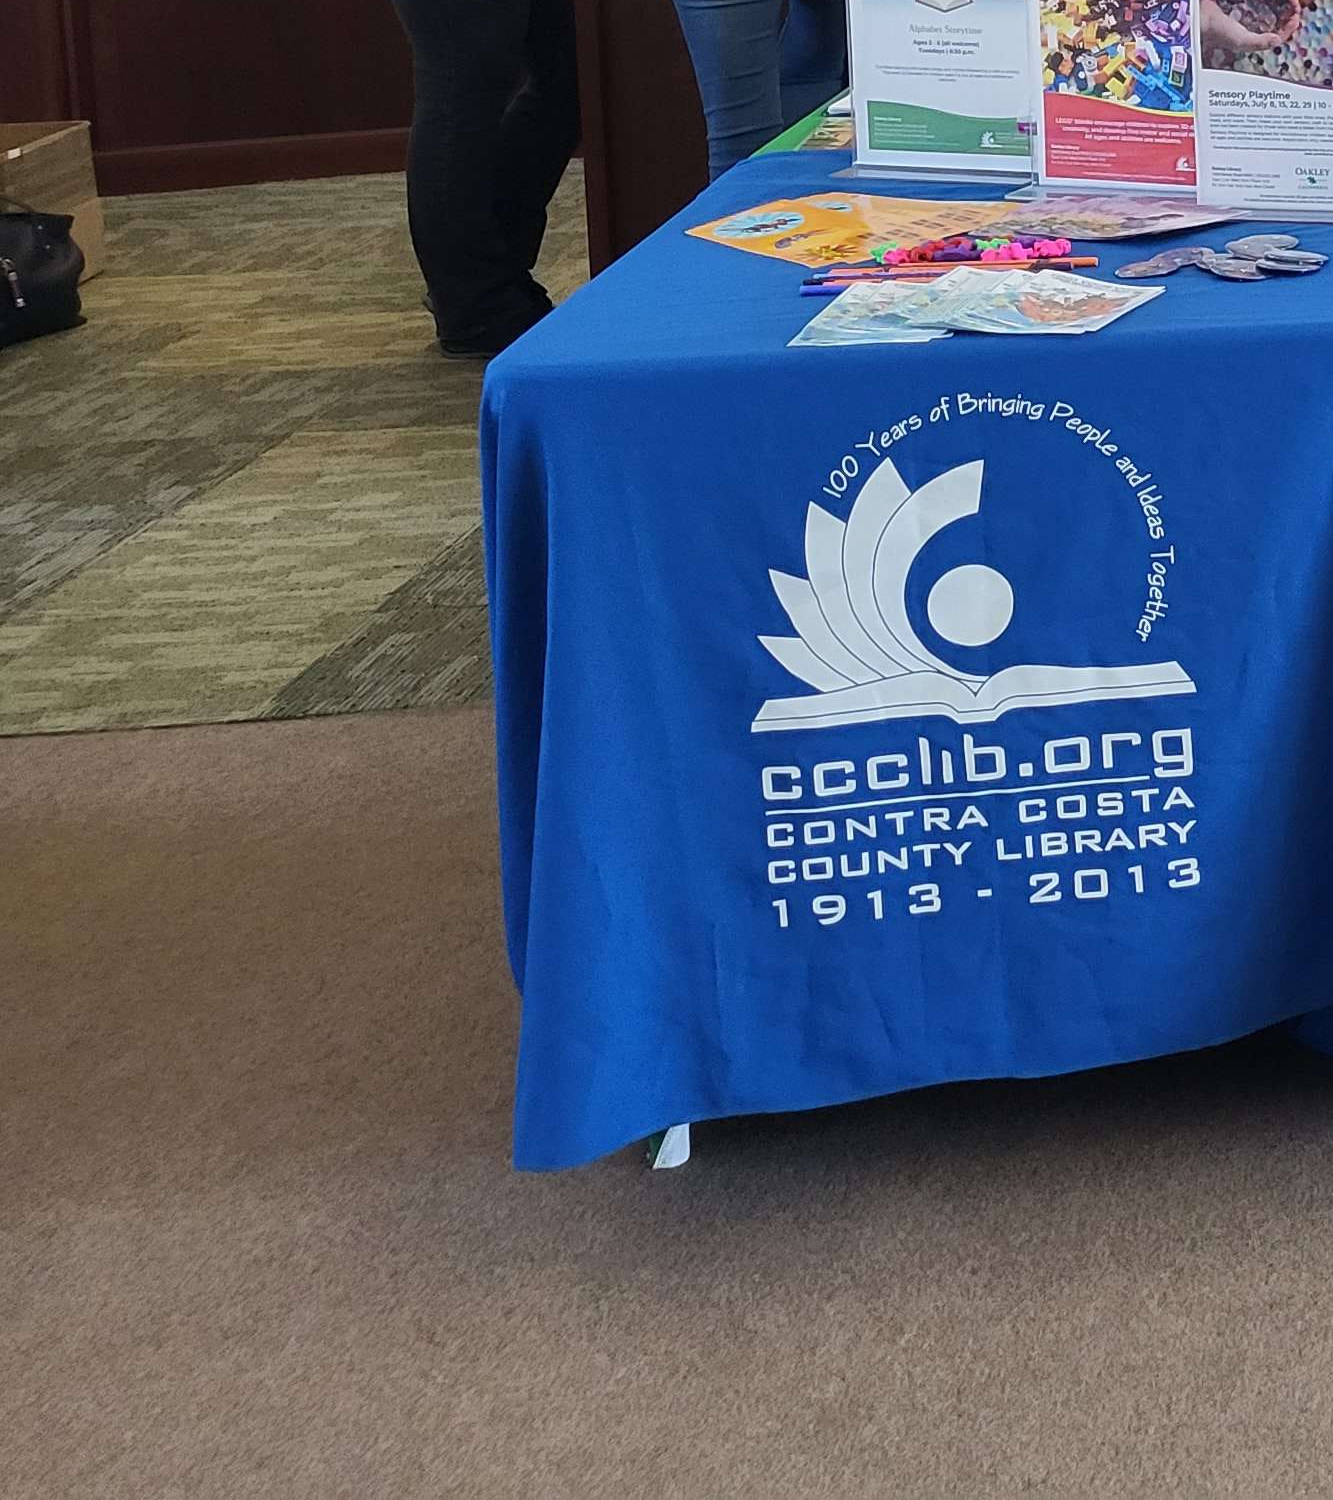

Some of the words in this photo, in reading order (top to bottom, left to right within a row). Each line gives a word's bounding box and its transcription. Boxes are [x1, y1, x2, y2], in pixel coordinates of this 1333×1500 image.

[945, 25, 983, 35] Storytime
[1208, 90, 1247, 101] Sensory
[1249, 90, 1290, 101] Playtime
[1209, 99, 1250, 109] Saturdays,
[1251, 100, 1270, 109] July
[1295, 167, 1330, 176] OAKLEY
[929, 396, 949, 423] of
[957, 391, 1047, 421] Bringing
[1049, 400, 1119, 458] People
[855, 411, 923, 459] Years
[822, 454, 861, 500] 100
[1115, 455, 1153, 490] and
[1136, 480, 1166, 541] Ideas
[1135, 543, 1176, 643] Together
[762, 727, 1194, 801] ccclib.org
[767, 805, 989, 848] CONTRA
[1018, 786, 1195, 823] COSTA
[768, 841, 972, 885] COUNTY
[996, 820, 1197, 862] LIBRARY
[771, 883, 943, 928] 1913
[1028, 857, 1202, 904] 2013
